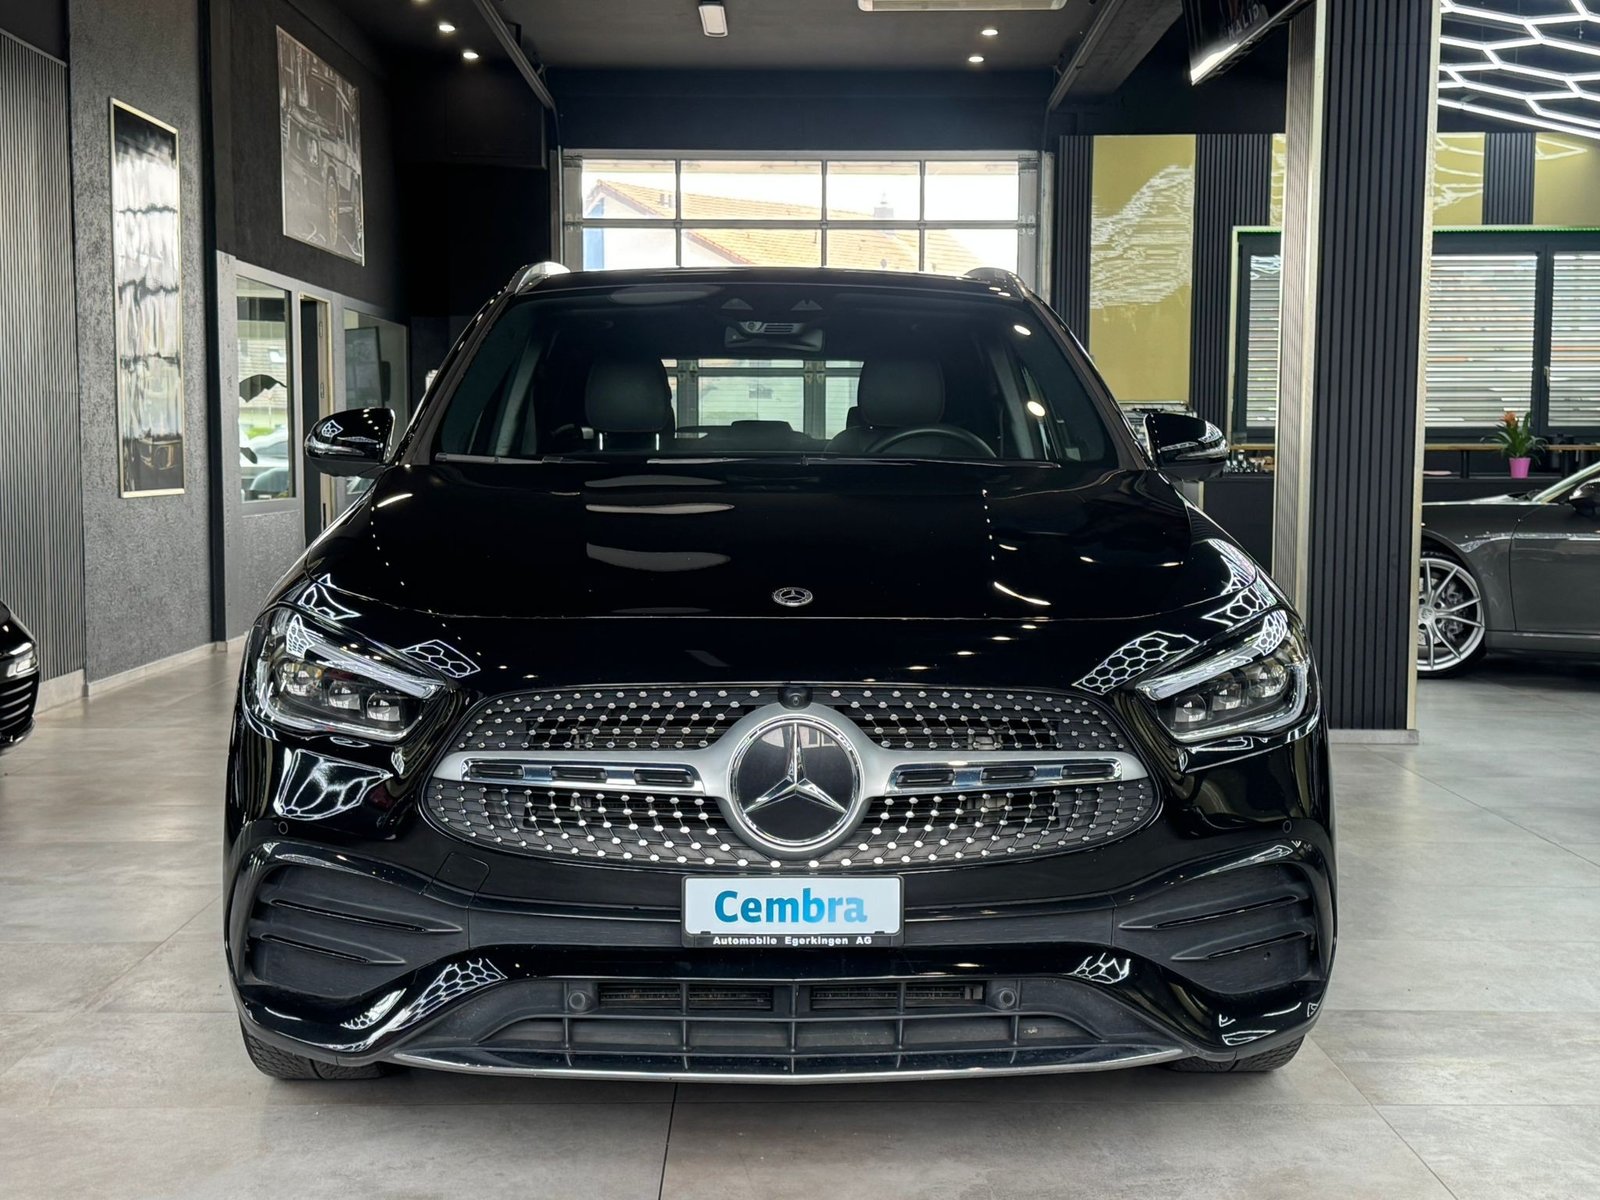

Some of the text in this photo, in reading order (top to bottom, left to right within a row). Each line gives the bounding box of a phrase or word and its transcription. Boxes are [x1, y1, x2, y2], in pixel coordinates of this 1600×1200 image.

[714, 887, 869, 924] Cembra
[713, 936, 873, 946] Automobile Egerkingen AG
